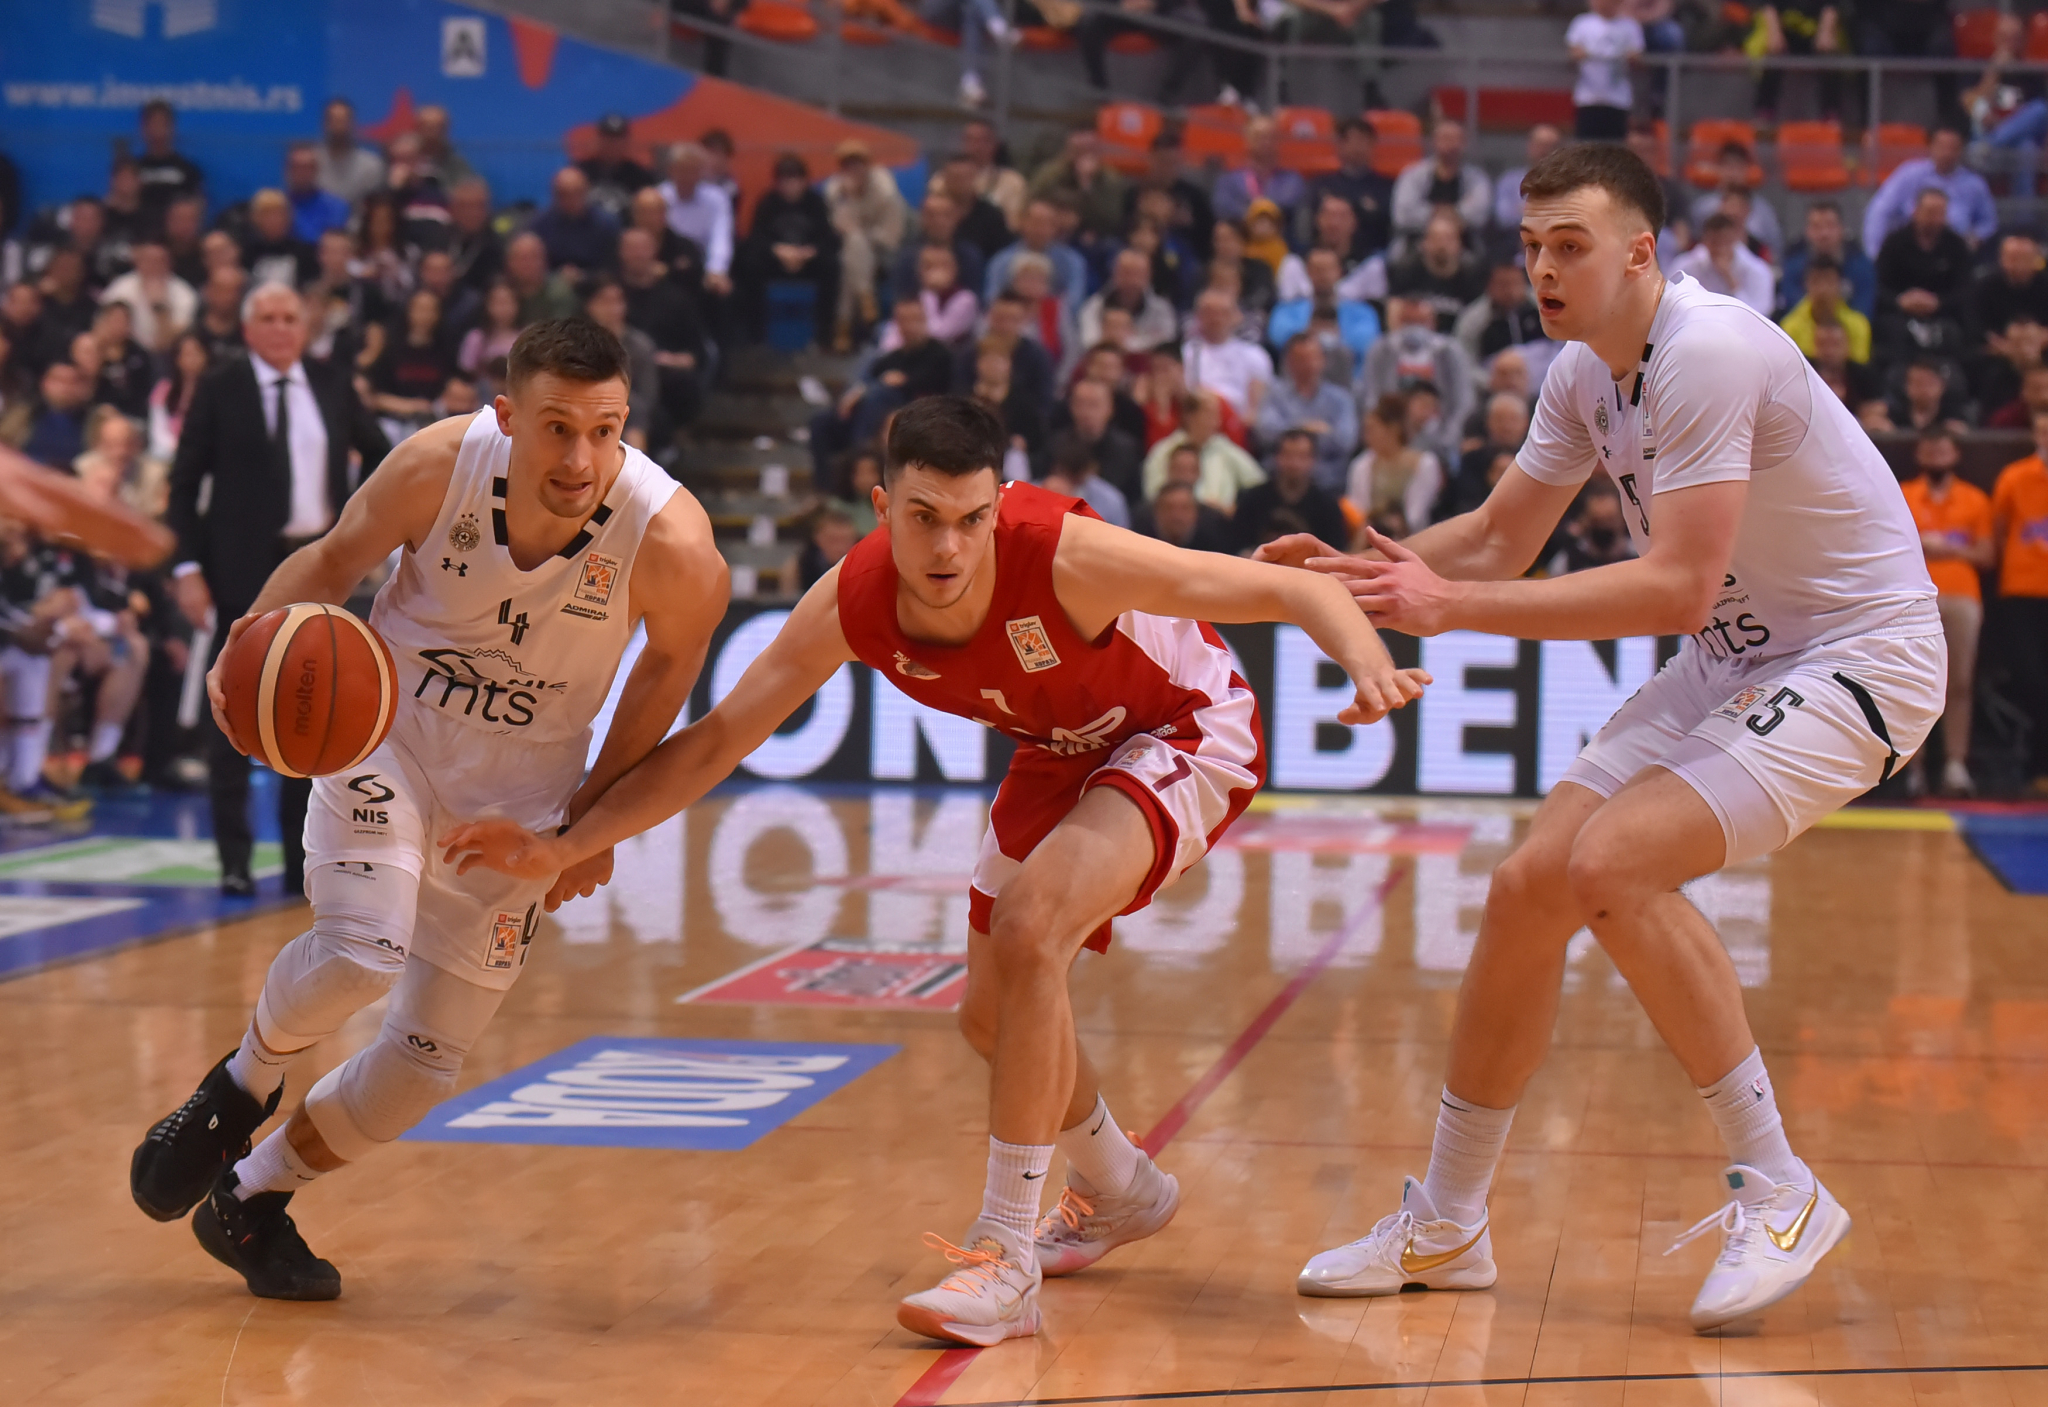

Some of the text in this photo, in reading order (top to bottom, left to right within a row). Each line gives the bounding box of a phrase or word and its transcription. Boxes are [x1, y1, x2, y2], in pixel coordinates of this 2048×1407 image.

[497, 597, 530, 646] 4
[564, 603, 609, 618] ADMIRAL
[295, 658, 317, 737] molten
[413, 667, 537, 727] mts
[1746, 686, 1805, 737] 5
[1152, 753, 1192, 793] 7
[353, 808, 389, 824] NIS
[444, 1050, 850, 1129] RODA
